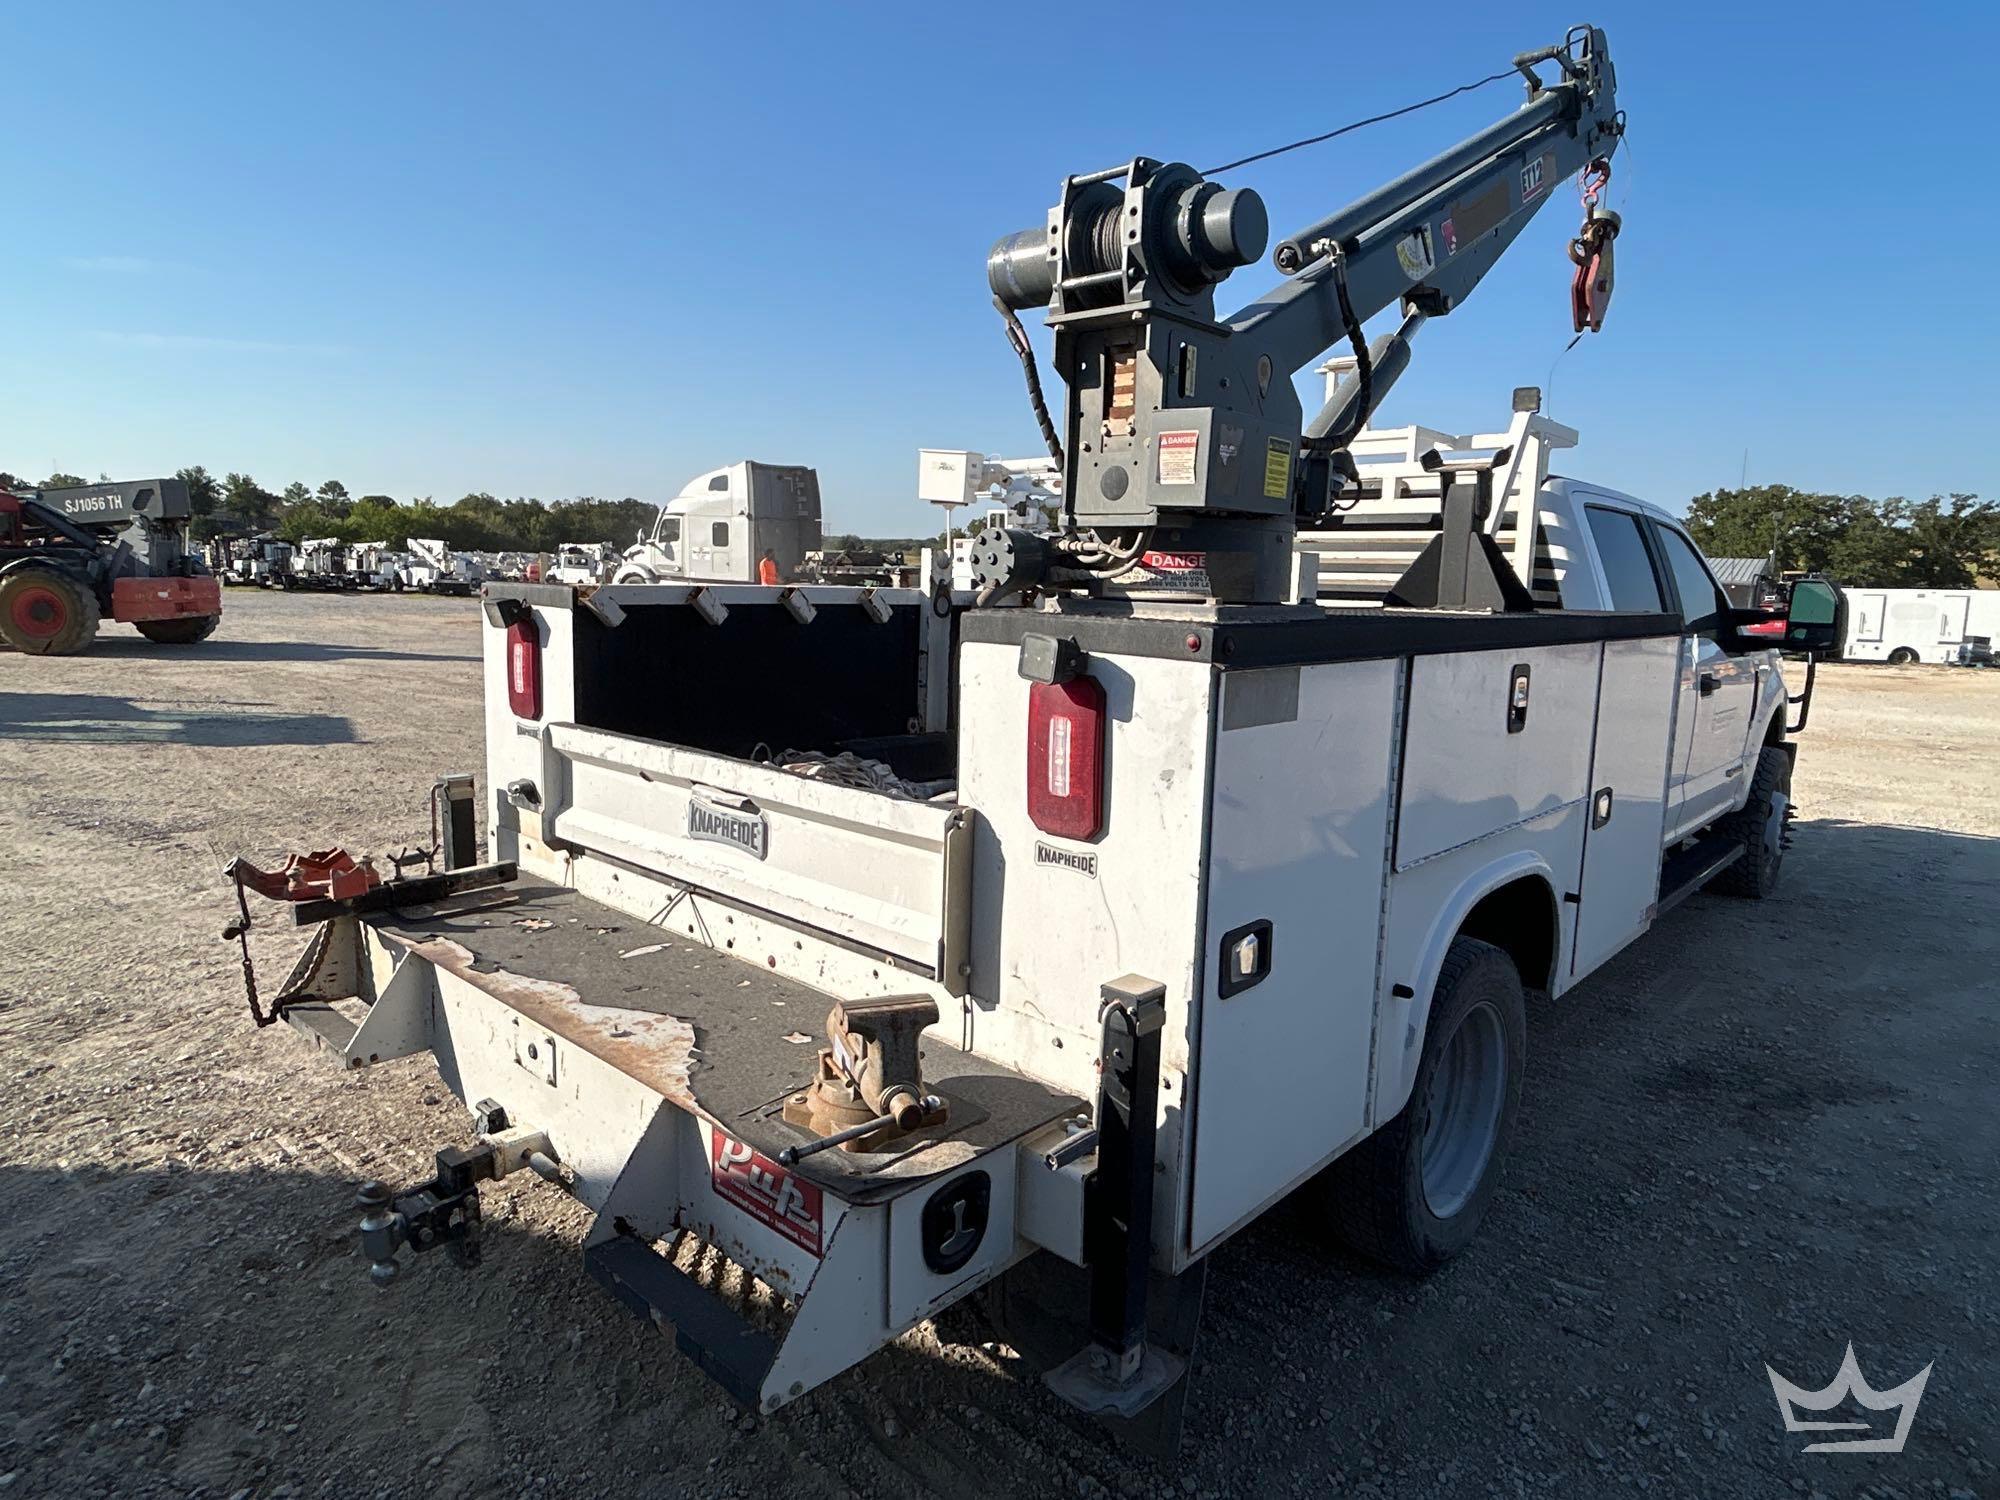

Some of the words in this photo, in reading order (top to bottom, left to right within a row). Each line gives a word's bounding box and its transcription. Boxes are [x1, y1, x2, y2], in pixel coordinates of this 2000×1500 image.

[1168, 435, 1197, 445] DANGER
[65, 497, 106, 513] SJ1056
[106, 494, 123, 510] TH
[1151, 555, 1206, 567] DANGE
[690, 802, 759, 852] KNAPHEIDE
[1037, 844, 1095, 875] KNAPHEIDE
